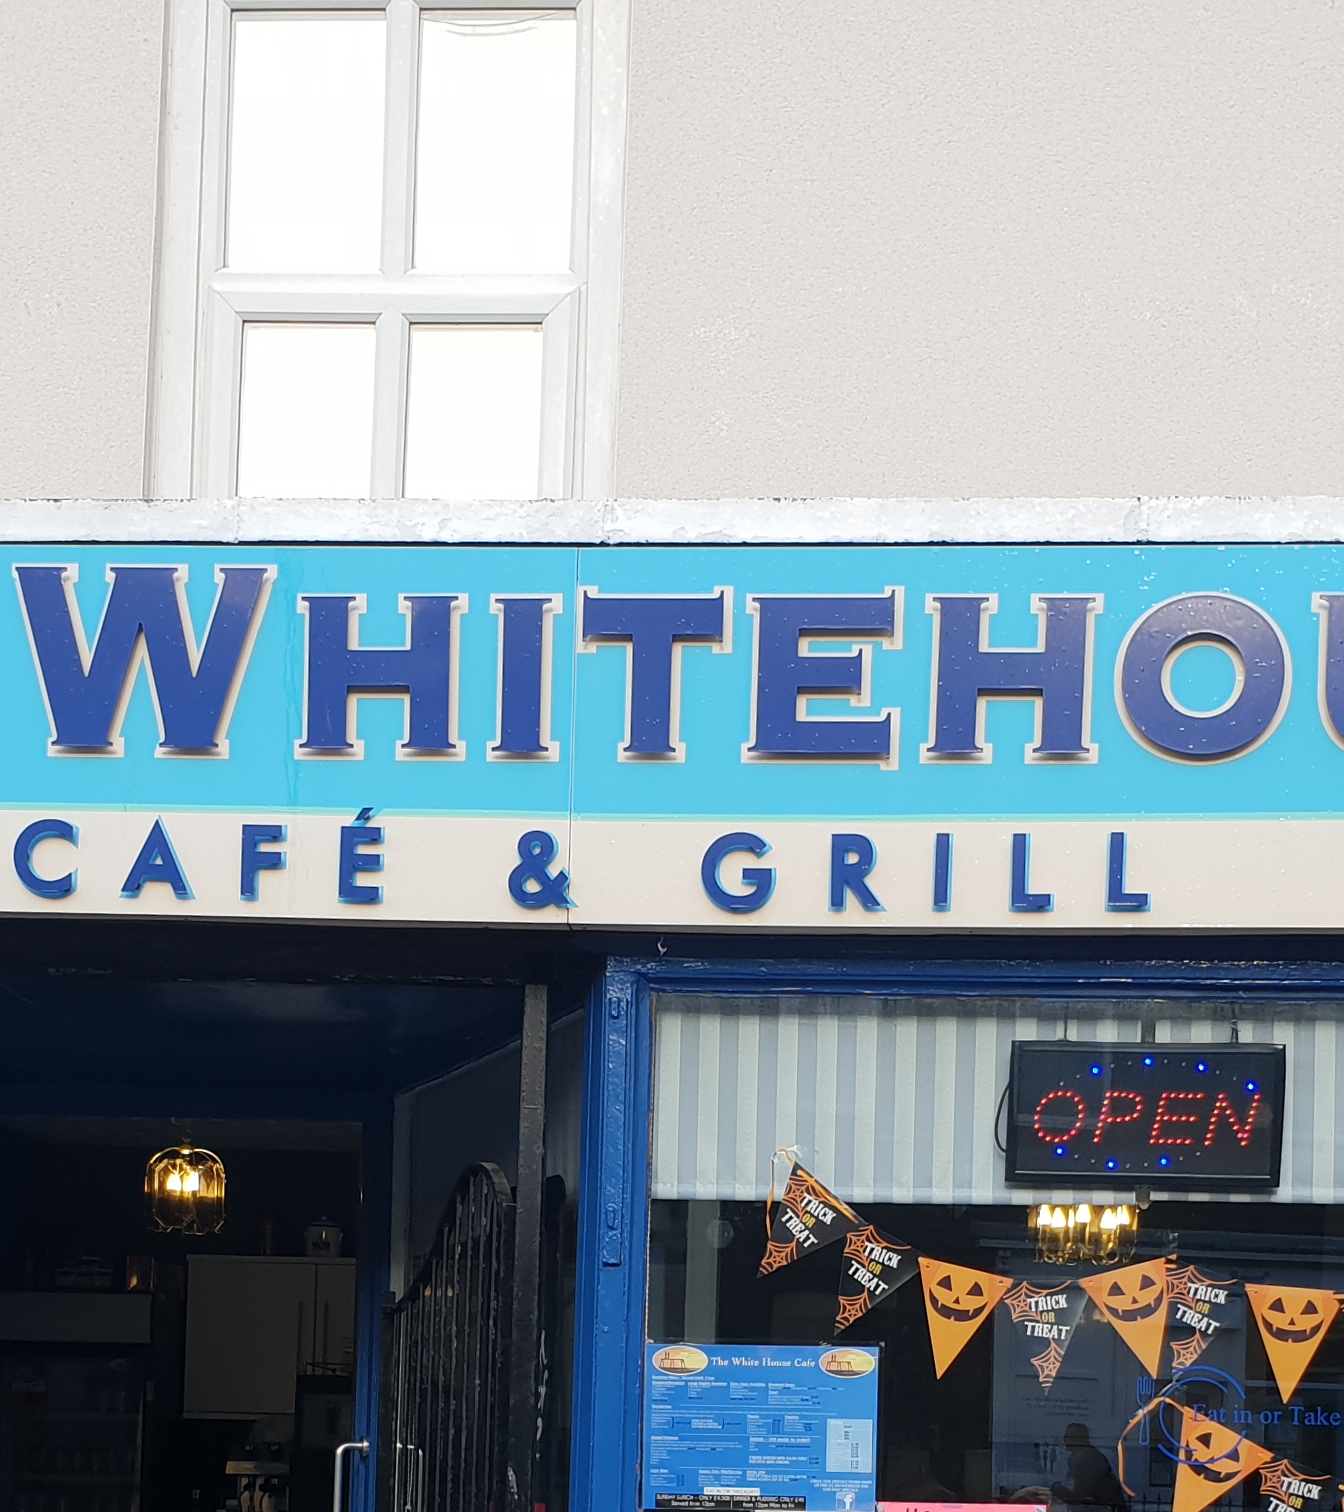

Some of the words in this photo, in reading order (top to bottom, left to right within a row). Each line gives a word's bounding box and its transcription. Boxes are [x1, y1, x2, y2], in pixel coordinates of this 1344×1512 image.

[14, 807, 393, 904] CAFÉ
[507, 828, 573, 910] &
[700, 830, 1152, 914] GRILL
[1033, 1089, 1262, 1147] OPEN
[798, 1193, 835, 1226] TRICK
[780, 1208, 819, 1249] TREAT
[802, 1214, 816, 1229] OR
[861, 1243, 902, 1270] TRICK
[847, 1260, 889, 1297] TREAT
[867, 1260, 882, 1277] OR
[1026, 1294, 1068, 1314] TRICK
[1186, 1282, 1228, 1305] TRICK
[1041, 1310, 1057, 1323] OR
[1195, 1300, 1210, 1315] OR
[1174, 1304, 1220, 1335] TREAT
[1024, 1322, 1070, 1341] TREAT
[711, 1356, 729, 1367] The
[732, 1356, 760, 1368] White
[762, 1357, 792, 1368] House
[794, 1357, 816, 1368] Cafe
[1193, 1404, 1226, 1423] Eat
[1233, 1404, 1252, 1424] in
[1259, 1409, 1282, 1425] or
[1288, 1406, 1341, 1426] Take
[1280, 1476, 1321, 1500] TRICK
[1287, 1494, 1304, 1509] OR
